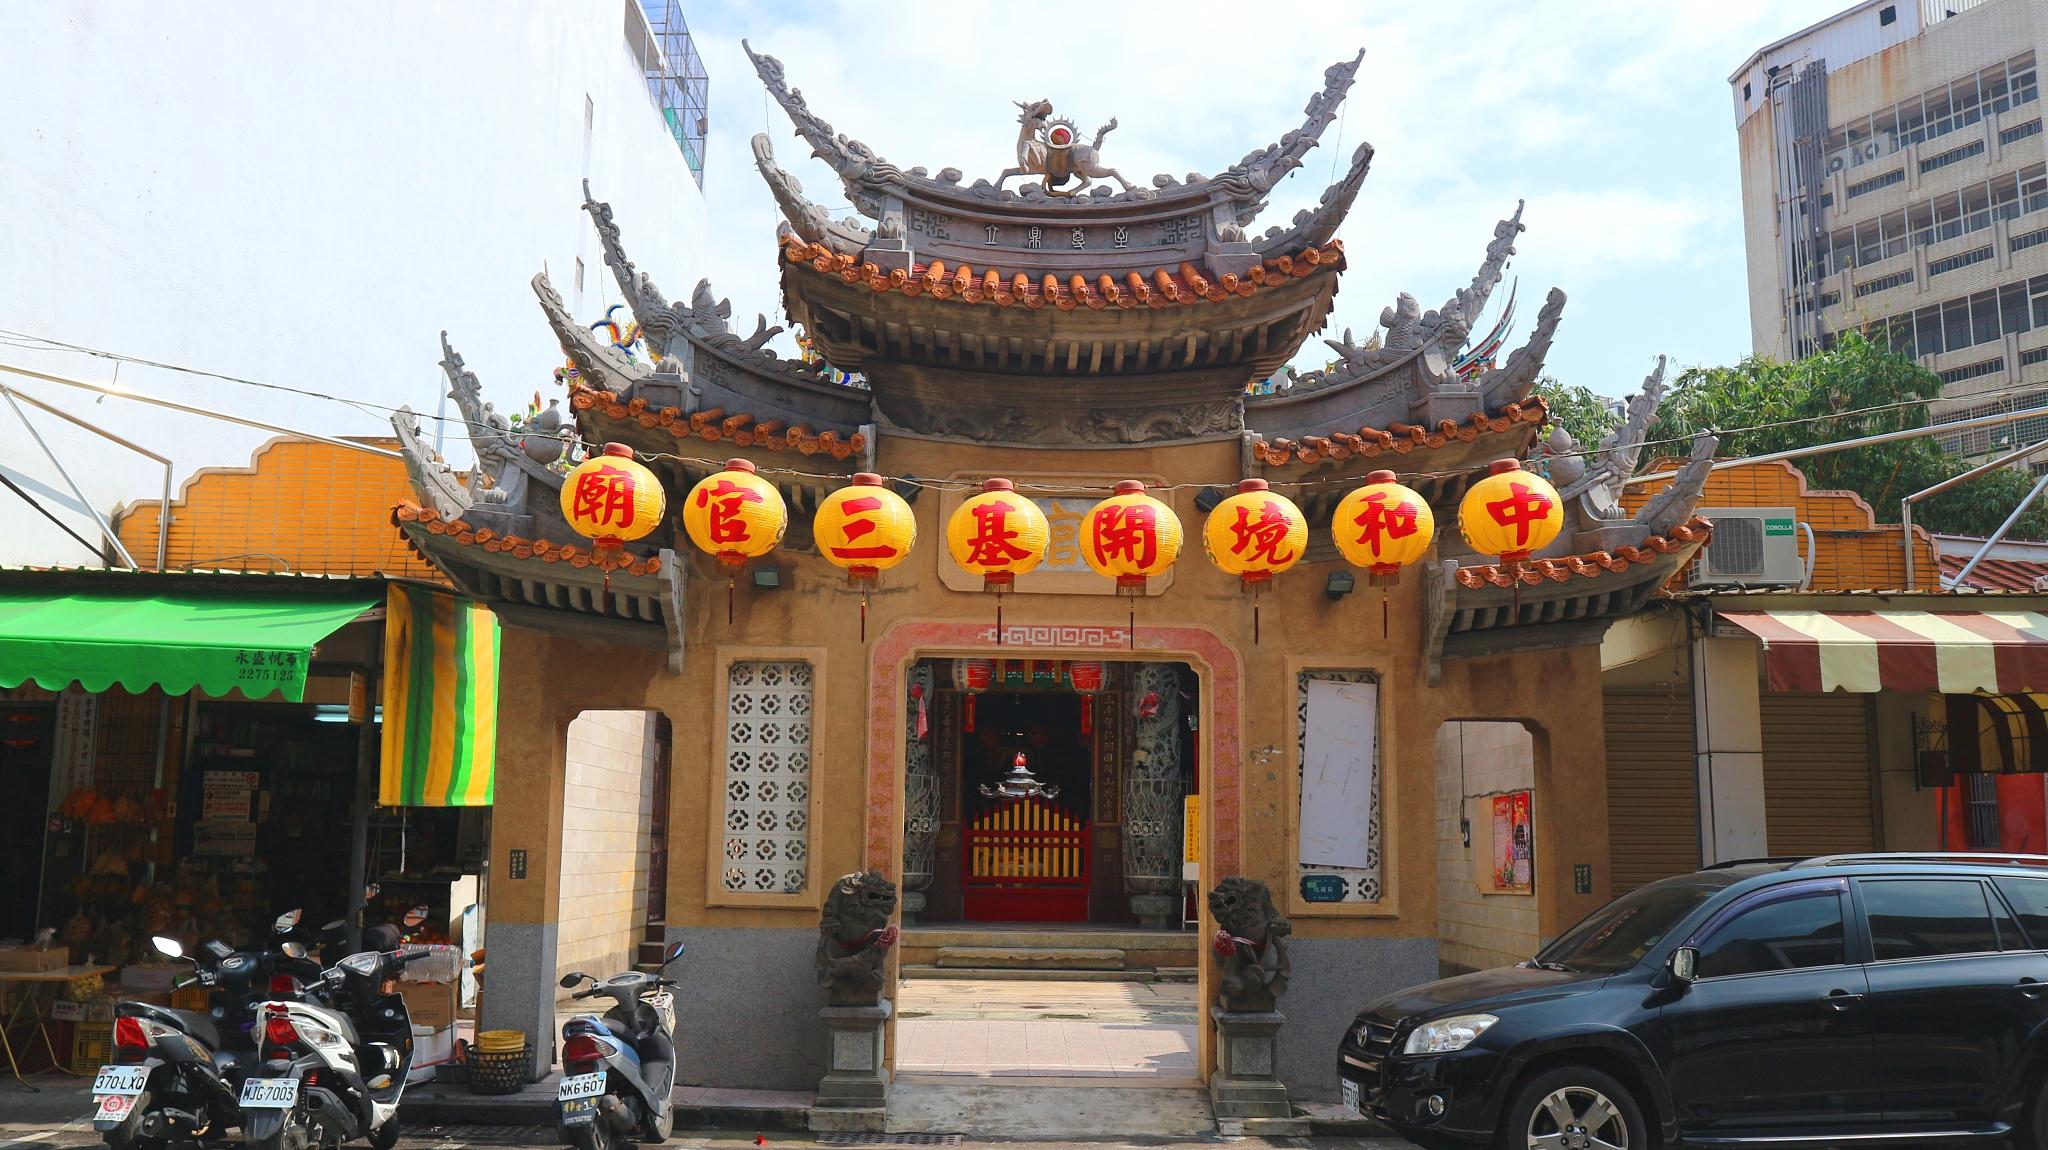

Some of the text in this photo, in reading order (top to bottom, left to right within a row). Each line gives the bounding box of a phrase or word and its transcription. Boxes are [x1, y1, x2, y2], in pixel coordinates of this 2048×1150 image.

[235, 650, 299, 667] 永盛帆布
[238, 668, 294, 681] 2275125
